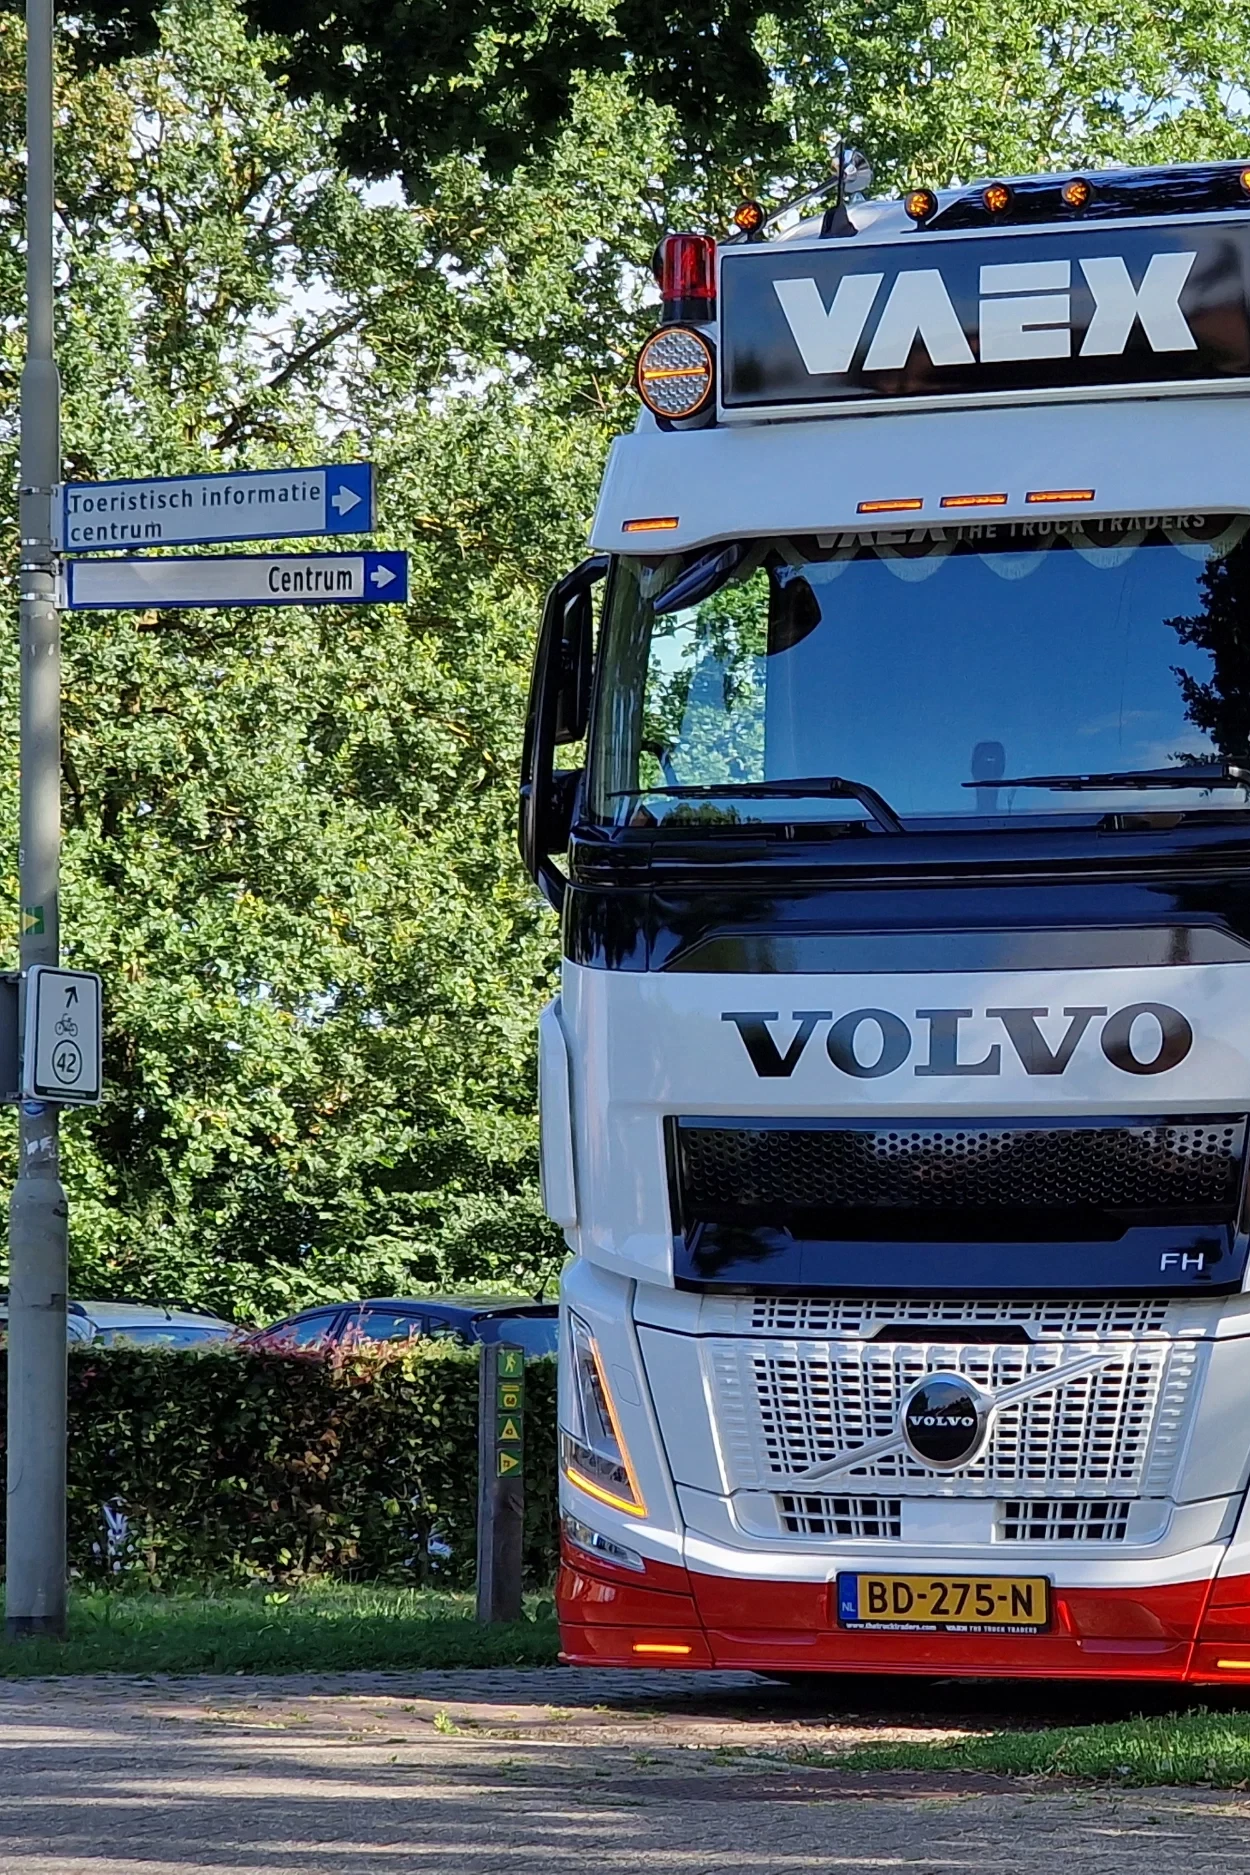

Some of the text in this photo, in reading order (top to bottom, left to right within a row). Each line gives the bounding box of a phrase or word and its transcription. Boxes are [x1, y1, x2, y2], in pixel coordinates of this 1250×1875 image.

[772, 251, 1198, 375] VAEX
[69, 481, 322, 514] Toeristisch informatie
[70, 519, 163, 541] centrum
[1009, 520, 1085, 538] TRUCK
[1098, 514, 1206, 533] TRADERS
[268, 566, 353, 593] Centrum
[720, 1001, 1194, 1079] VOLVO
[57, 1053, 76, 1073] 42
[1160, 1252, 1205, 1272] FH
[908, 1415, 975, 1427] VOLVO
[841, 1602, 856, 1613] NL
[867, 1581, 1033, 1618] BD-275-N
